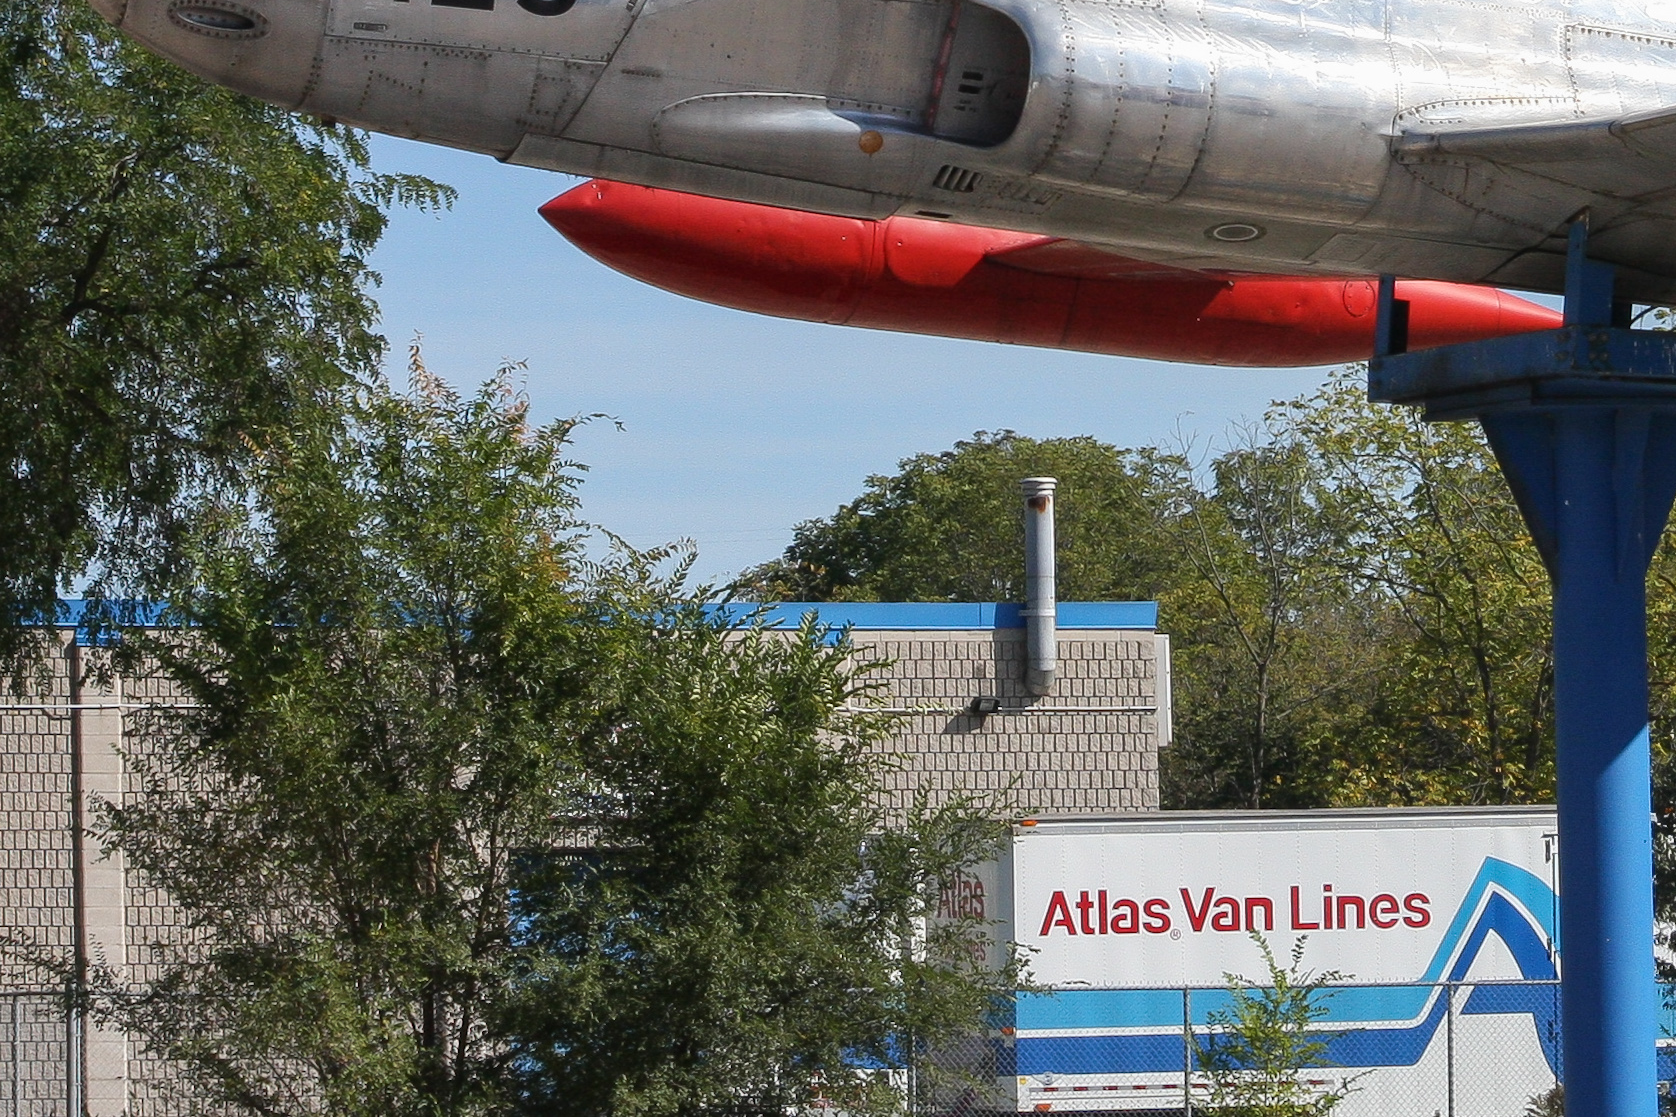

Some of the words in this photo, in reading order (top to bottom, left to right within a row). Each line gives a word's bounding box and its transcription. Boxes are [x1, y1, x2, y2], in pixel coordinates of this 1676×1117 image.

[1039, 889, 1172, 936] Atlas
[1179, 886, 1275, 932] Van
[1290, 884, 1432, 931] Lines
